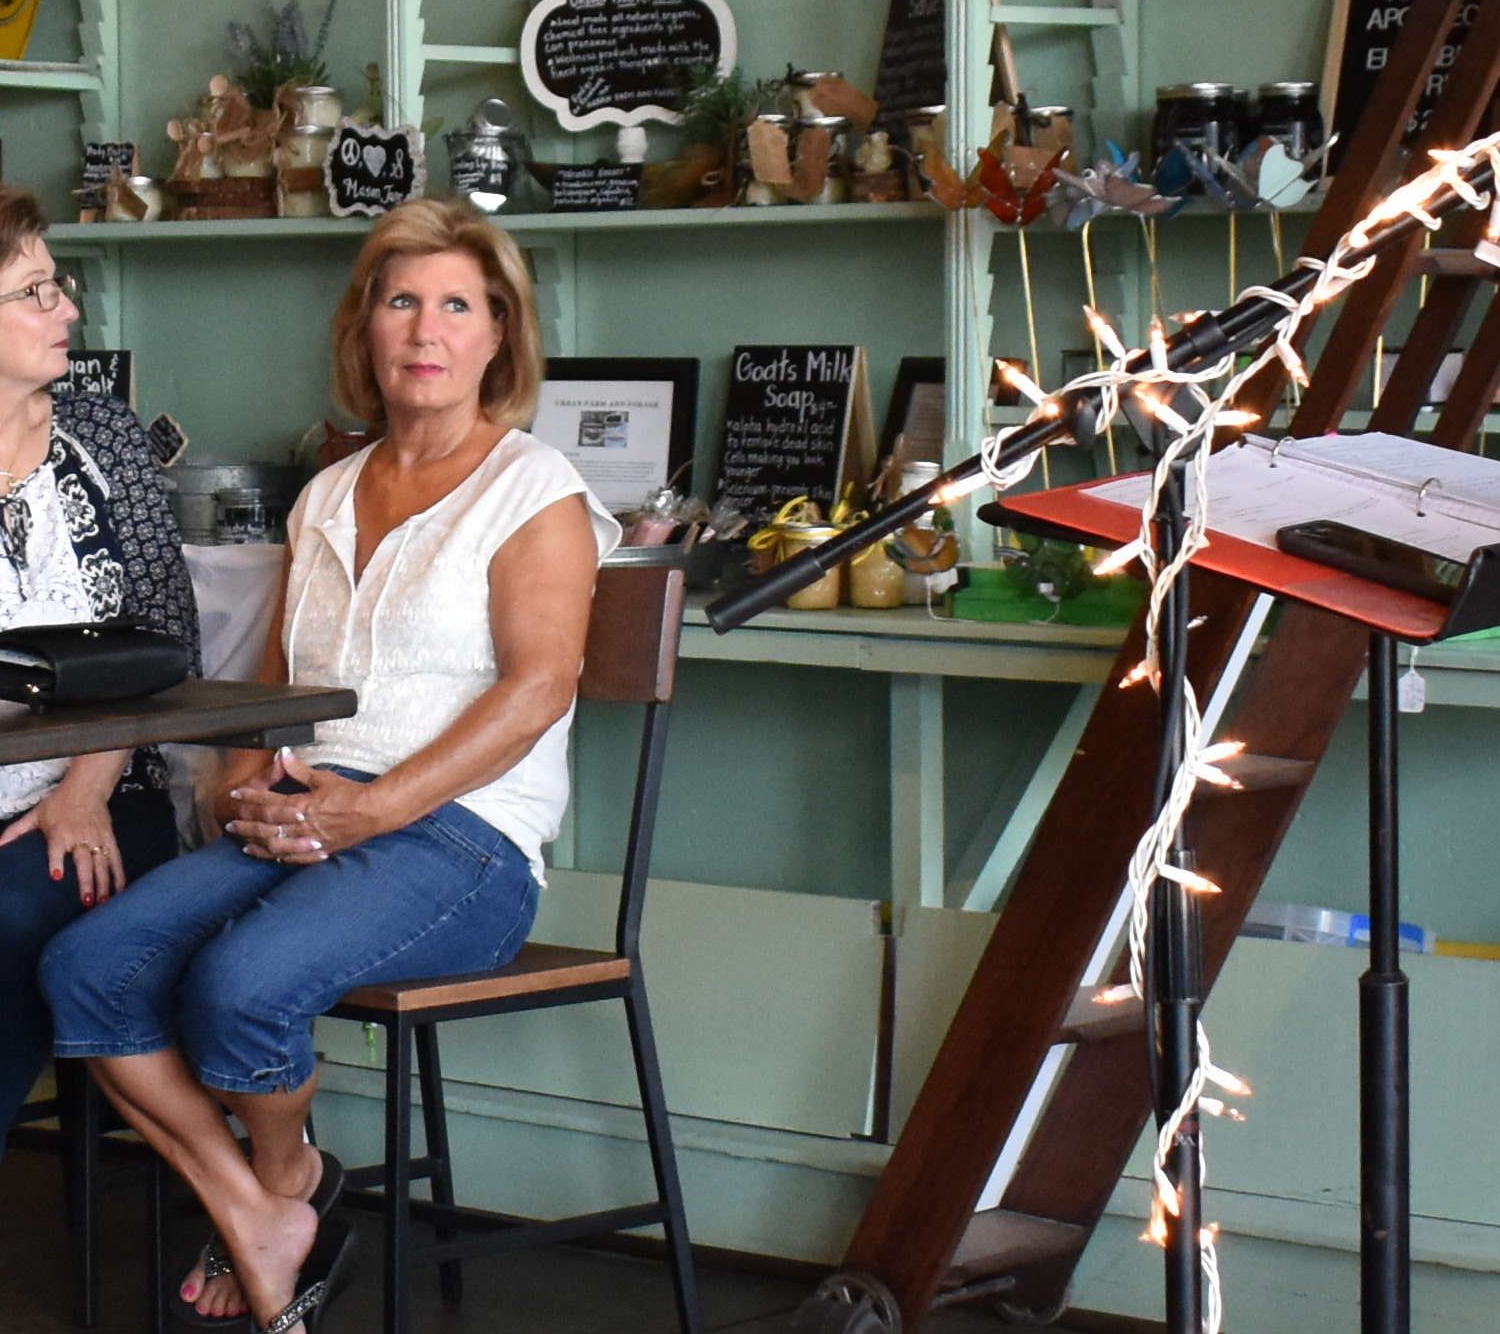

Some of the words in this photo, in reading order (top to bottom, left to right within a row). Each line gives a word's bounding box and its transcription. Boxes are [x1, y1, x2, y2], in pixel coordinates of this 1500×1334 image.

[343, 177, 381, 199] Mason
[735, 348, 798, 383] Goats
[805, 349, 851, 384] Milk
[81, 373, 116, 394] Salt
[764, 383, 815, 424] Soap
